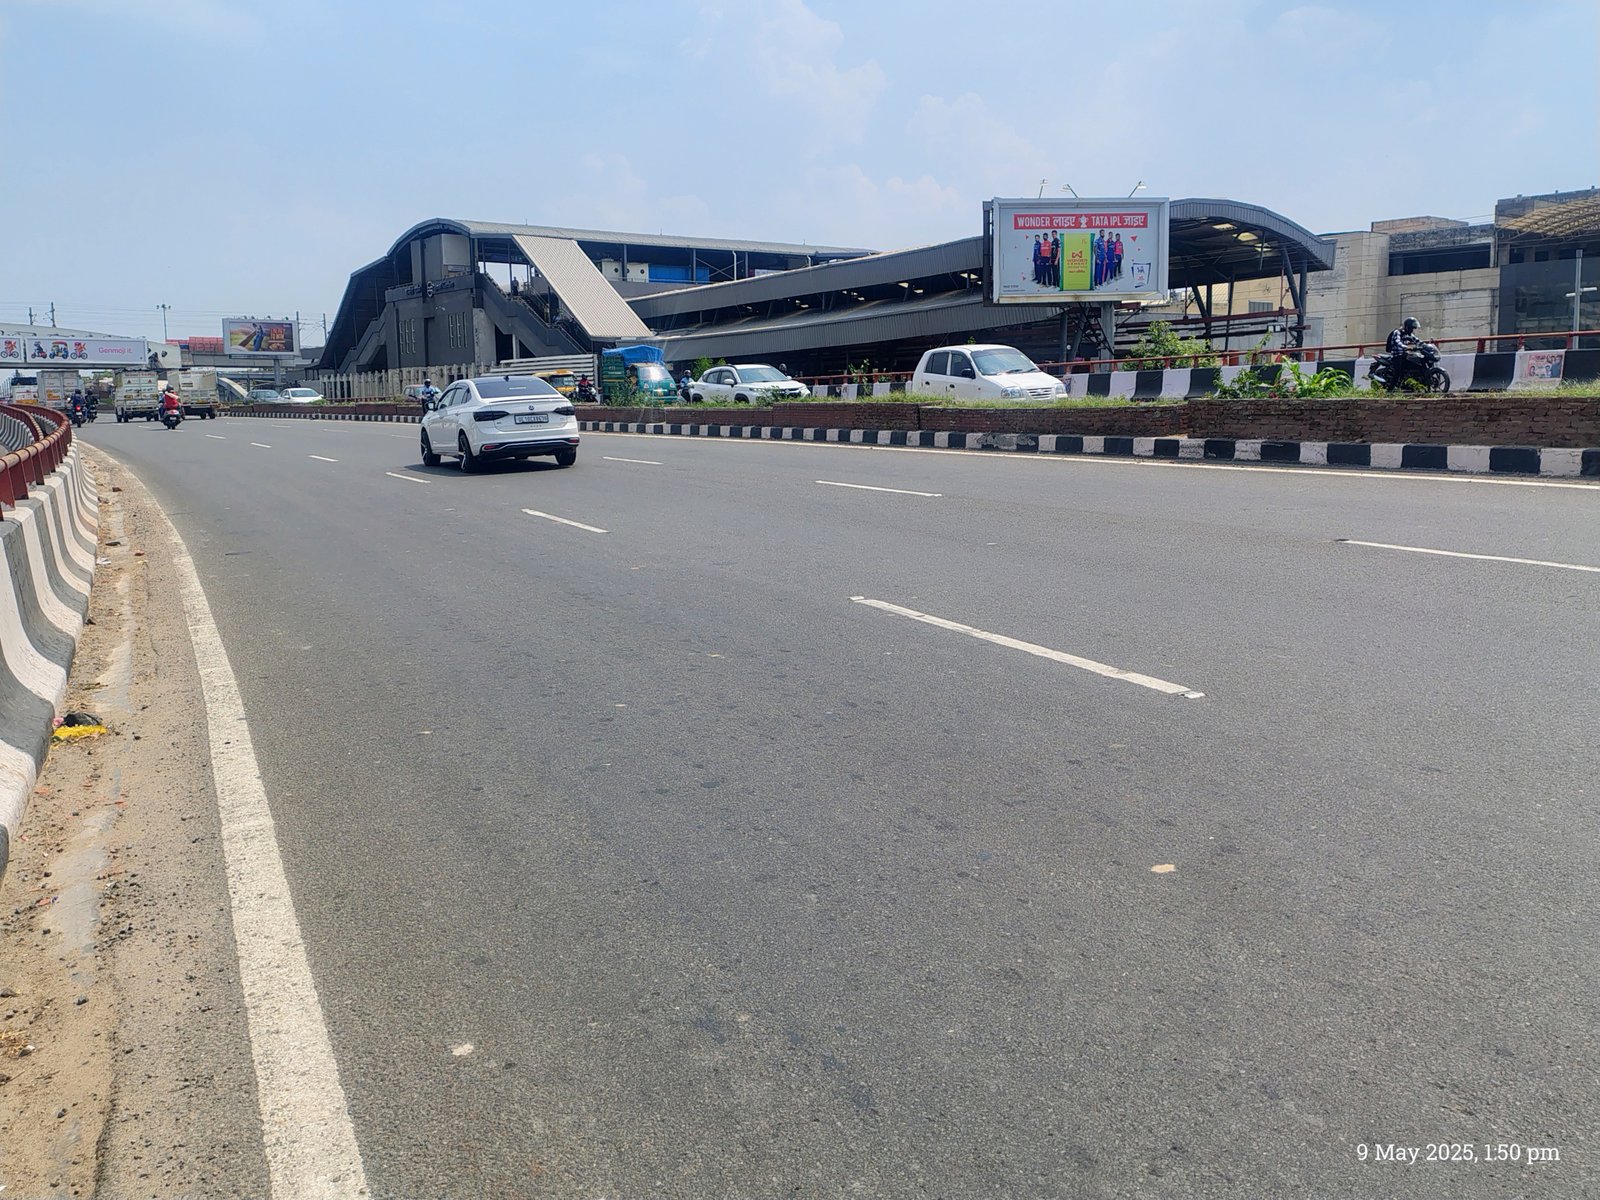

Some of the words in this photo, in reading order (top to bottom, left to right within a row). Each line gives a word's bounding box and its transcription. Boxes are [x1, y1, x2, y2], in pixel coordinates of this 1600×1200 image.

[1017, 216, 1051, 227] WONDER
[1052, 216, 1076, 227] लाइए
[1091, 215, 1109, 226] TATA
[1110, 215, 1122, 226] IPL
[1122, 215, 1146, 227] जाइए
